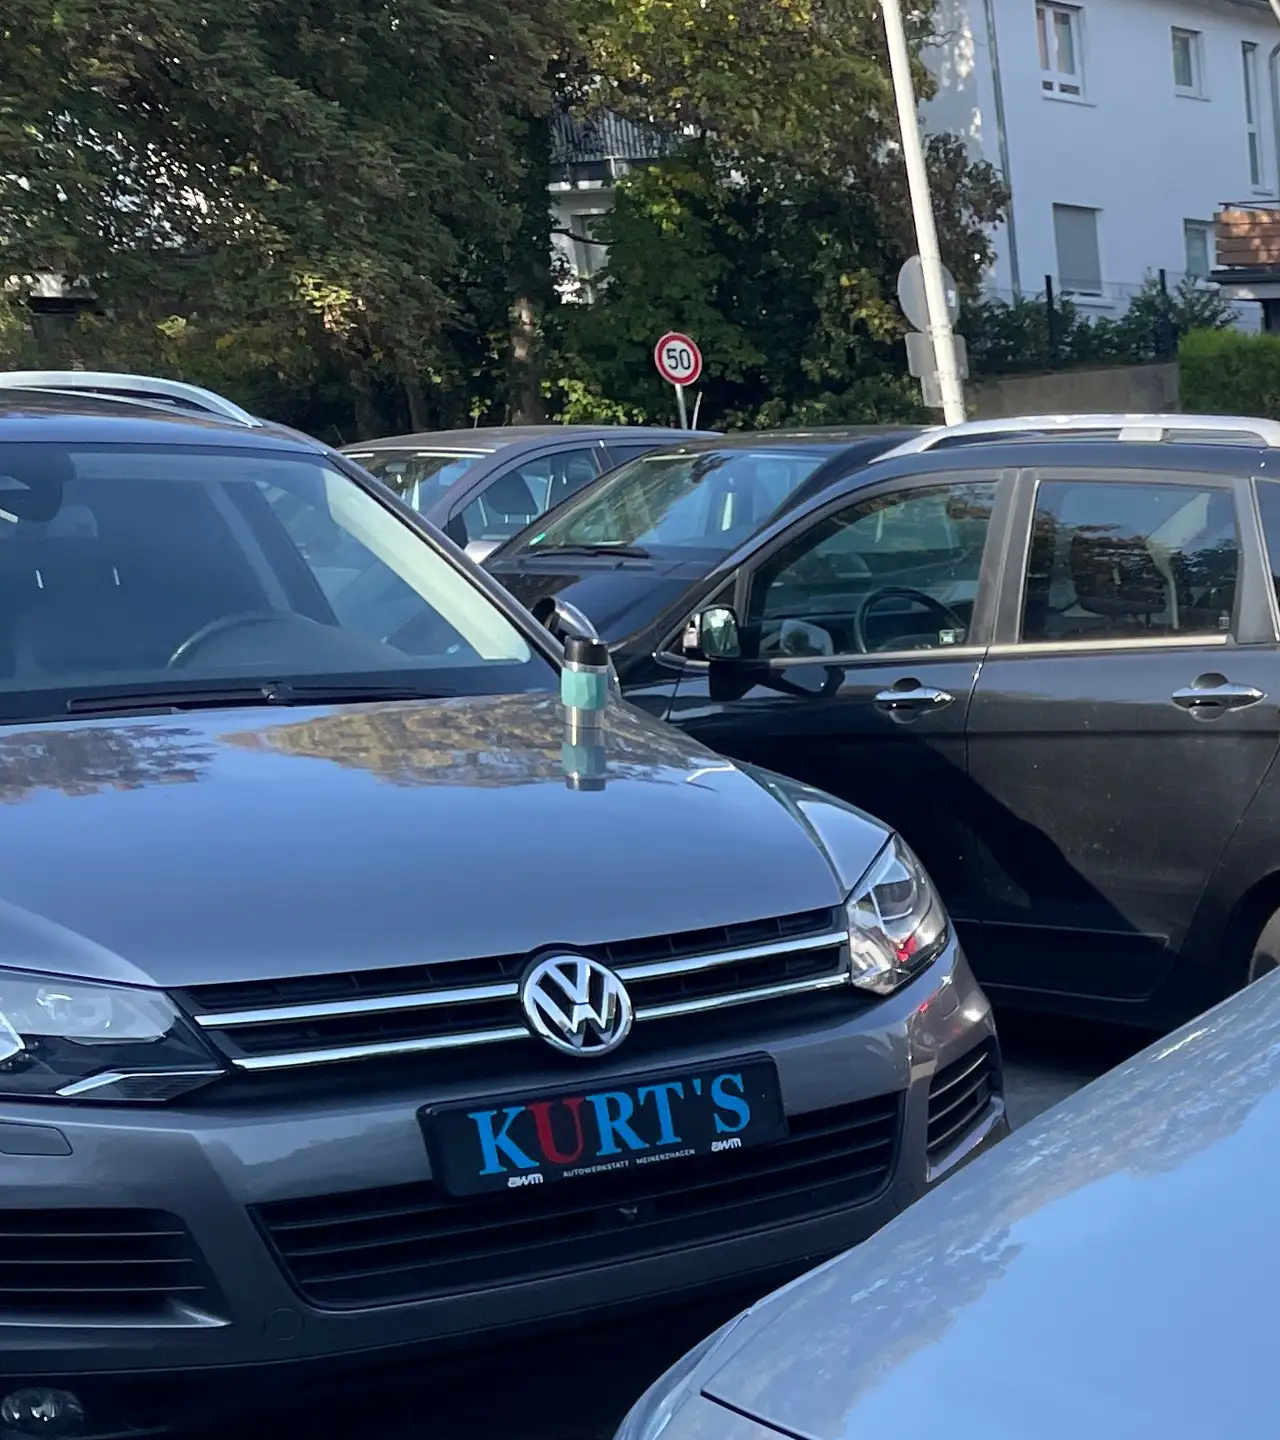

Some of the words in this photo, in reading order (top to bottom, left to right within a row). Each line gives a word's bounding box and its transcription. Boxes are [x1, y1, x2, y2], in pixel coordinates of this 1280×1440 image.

[666, 348, 692, 370] 50
[468, 1072, 751, 1177] KURT'S
[562, 1160, 630, 1178] AUTOWERKSTATT
